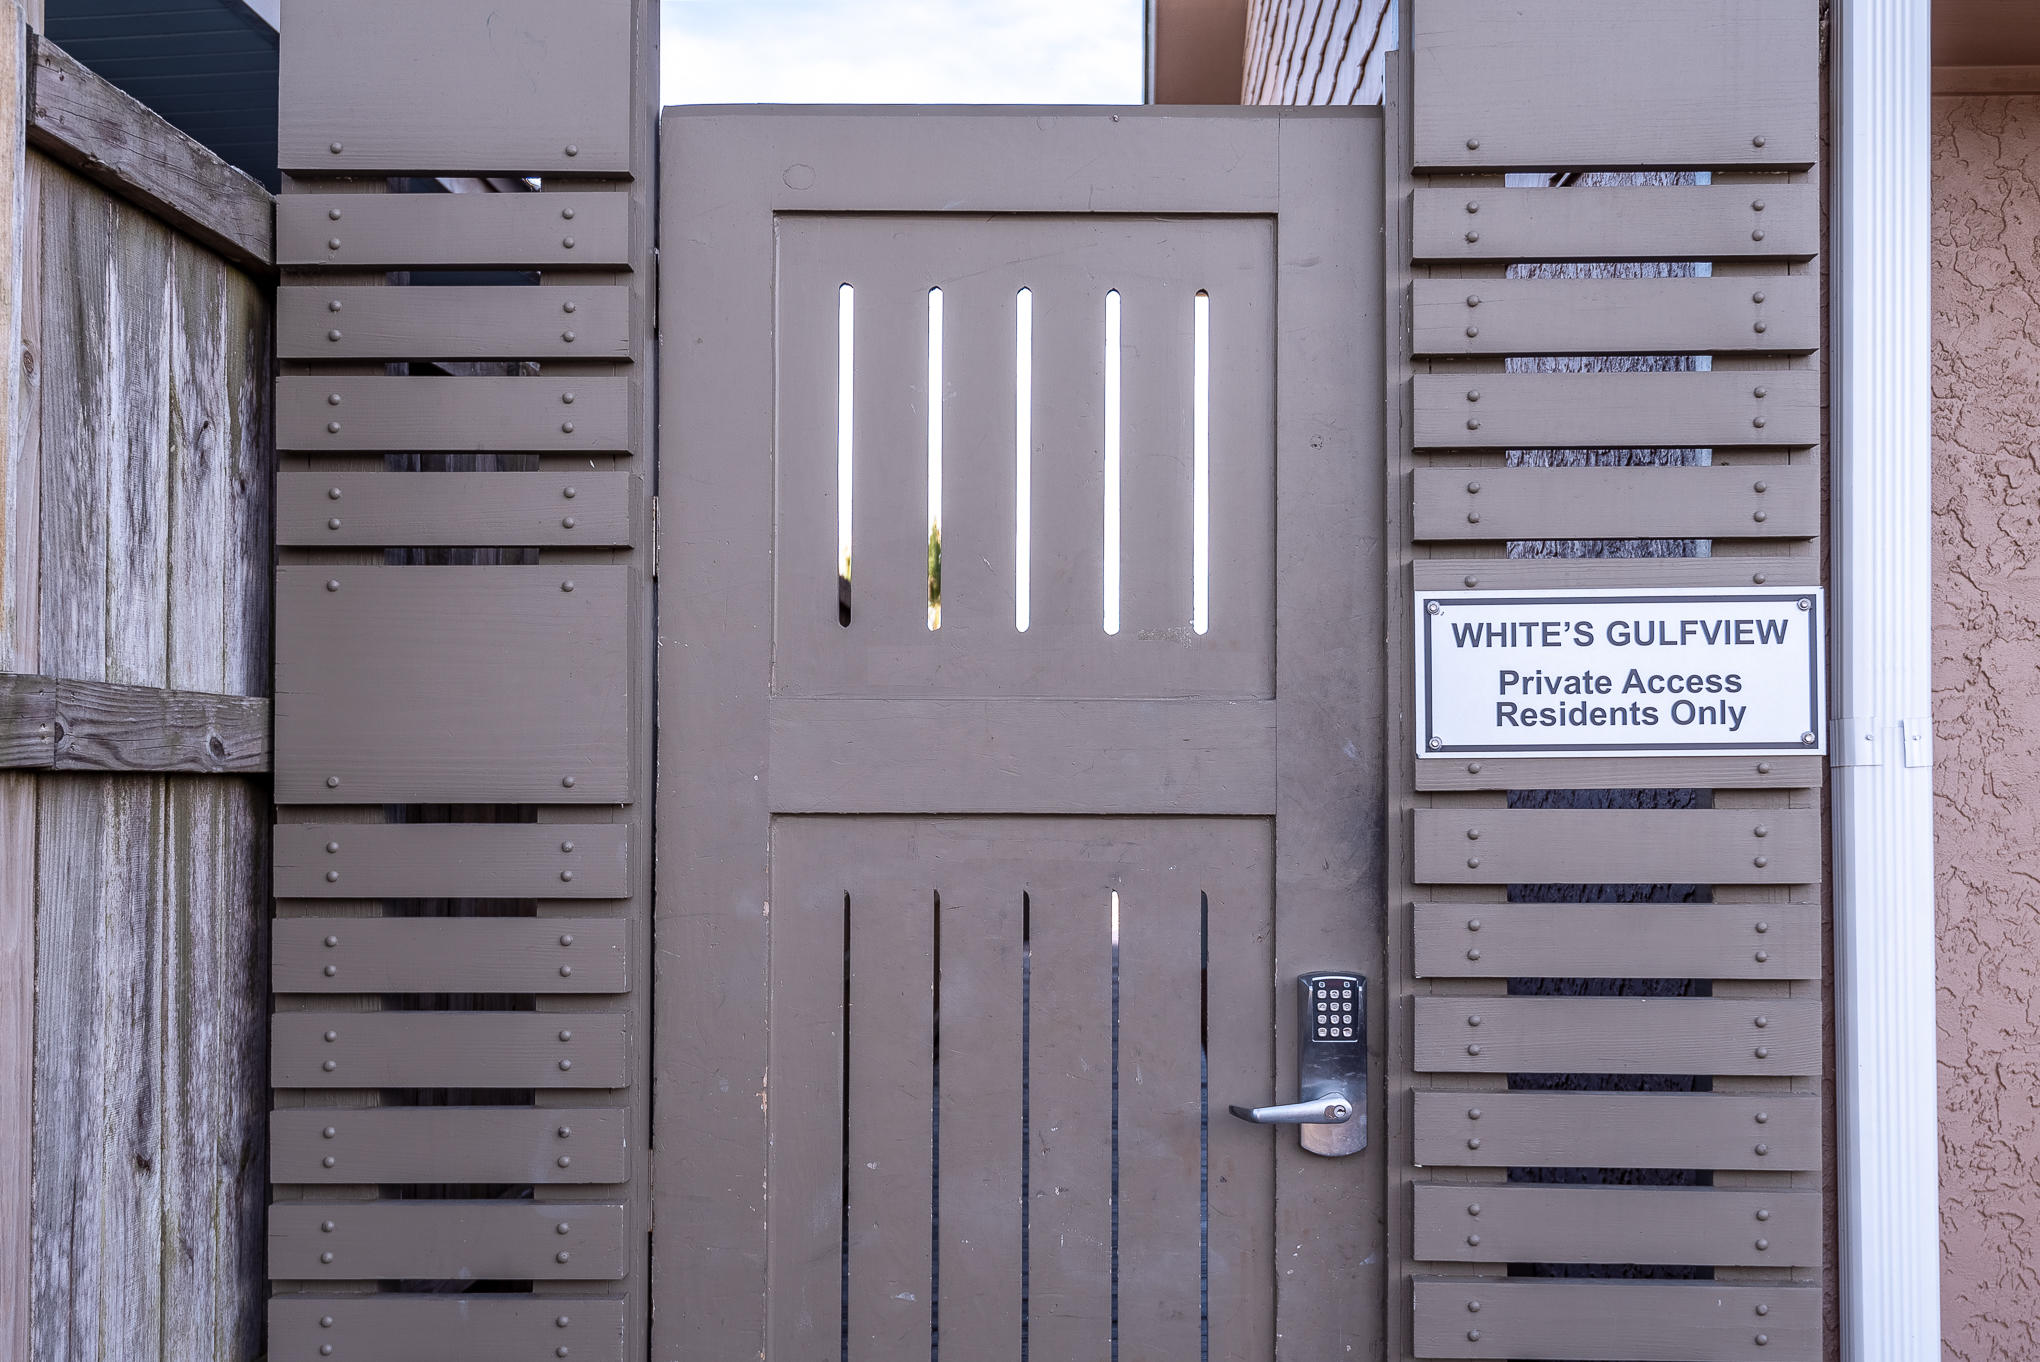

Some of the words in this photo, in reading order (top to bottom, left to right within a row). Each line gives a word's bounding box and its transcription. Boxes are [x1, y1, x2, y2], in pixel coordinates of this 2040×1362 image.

[1451, 620, 1595, 648] WHITE'S
[1606, 619, 1789, 647] GULFVIEW
[1499, 669, 1613, 696] Private
[1621, 668, 1742, 694] Access
[1496, 700, 1659, 727] Residents
[1671, 699, 1747, 732] Only
